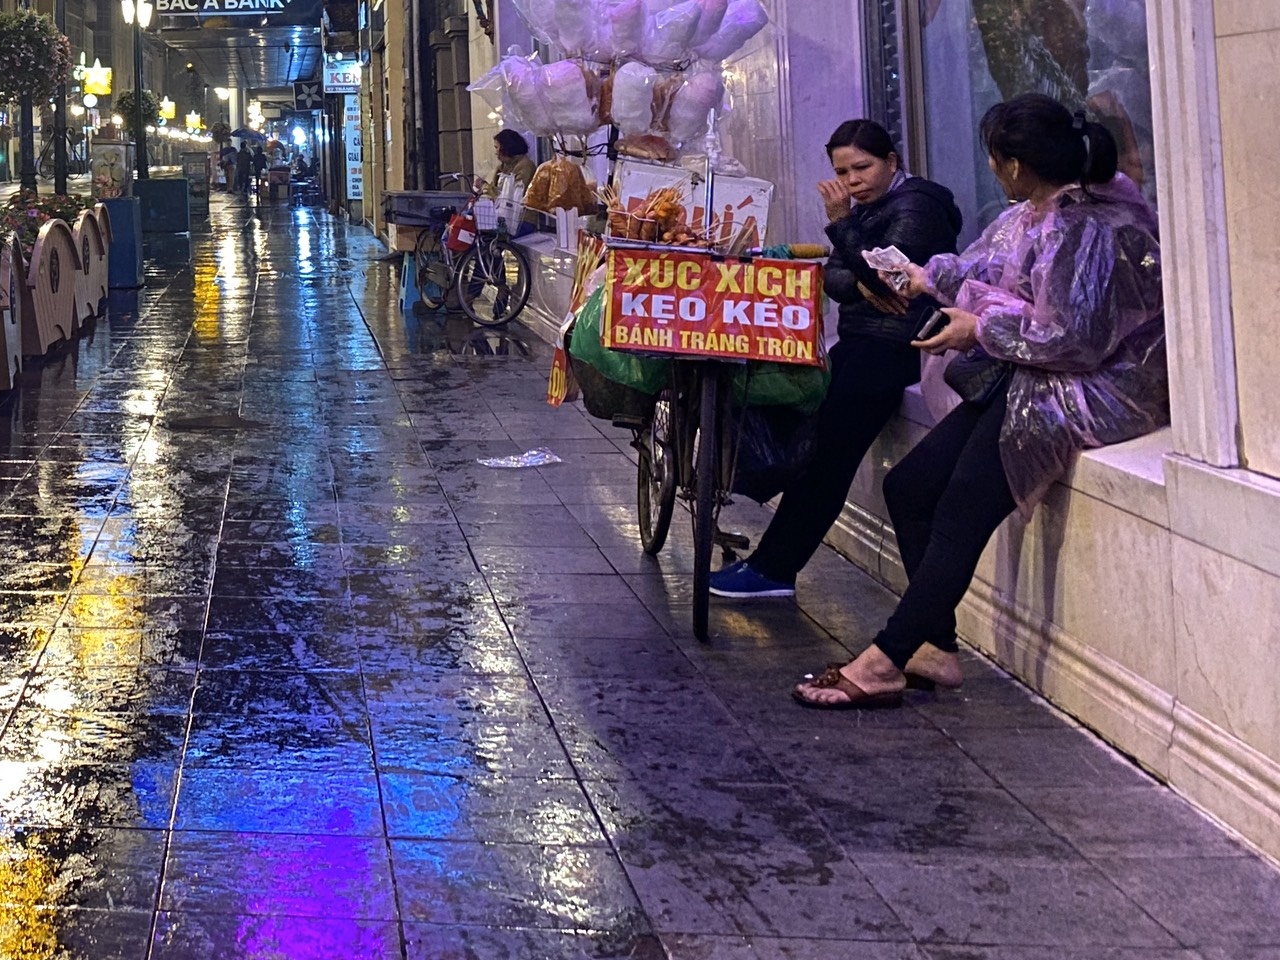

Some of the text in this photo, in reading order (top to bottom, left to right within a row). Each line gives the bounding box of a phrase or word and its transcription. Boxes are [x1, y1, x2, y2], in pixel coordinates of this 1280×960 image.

[623, 253, 702, 291] XÚC
[621, 292, 810, 330] KẸO KÉO
[615, 323, 813, 362] BÁNH TRÁNG TRỘN
